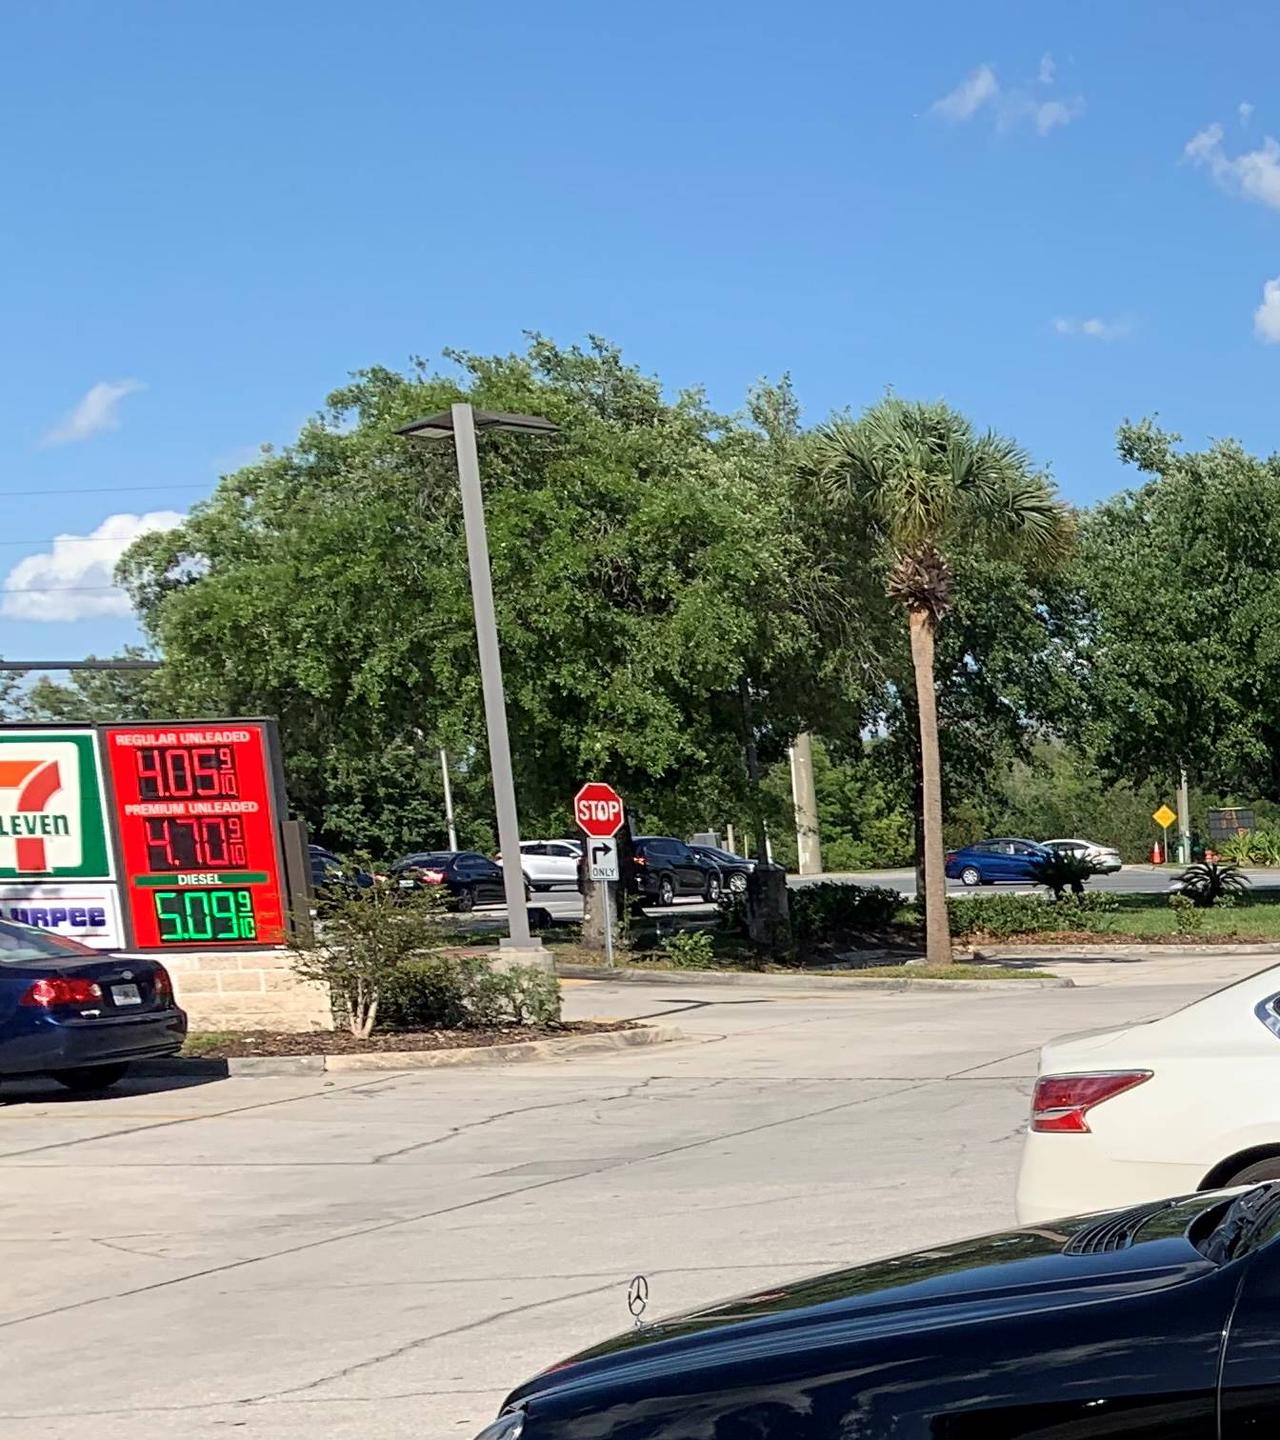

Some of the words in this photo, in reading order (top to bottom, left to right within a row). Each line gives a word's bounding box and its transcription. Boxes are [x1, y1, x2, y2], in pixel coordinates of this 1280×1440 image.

[115, 733, 177, 746] REGULAR
[180, 731, 250, 745] UNLEADED
[0, 760, 61, 871] 7
[124, 804, 185, 816] PREMIUM
[189, 801, 259, 815] UNLEADED
[579, 800, 619, 821] STOP
[177, 873, 223, 885] DIESEL
[592, 867, 616, 877] ONLY
